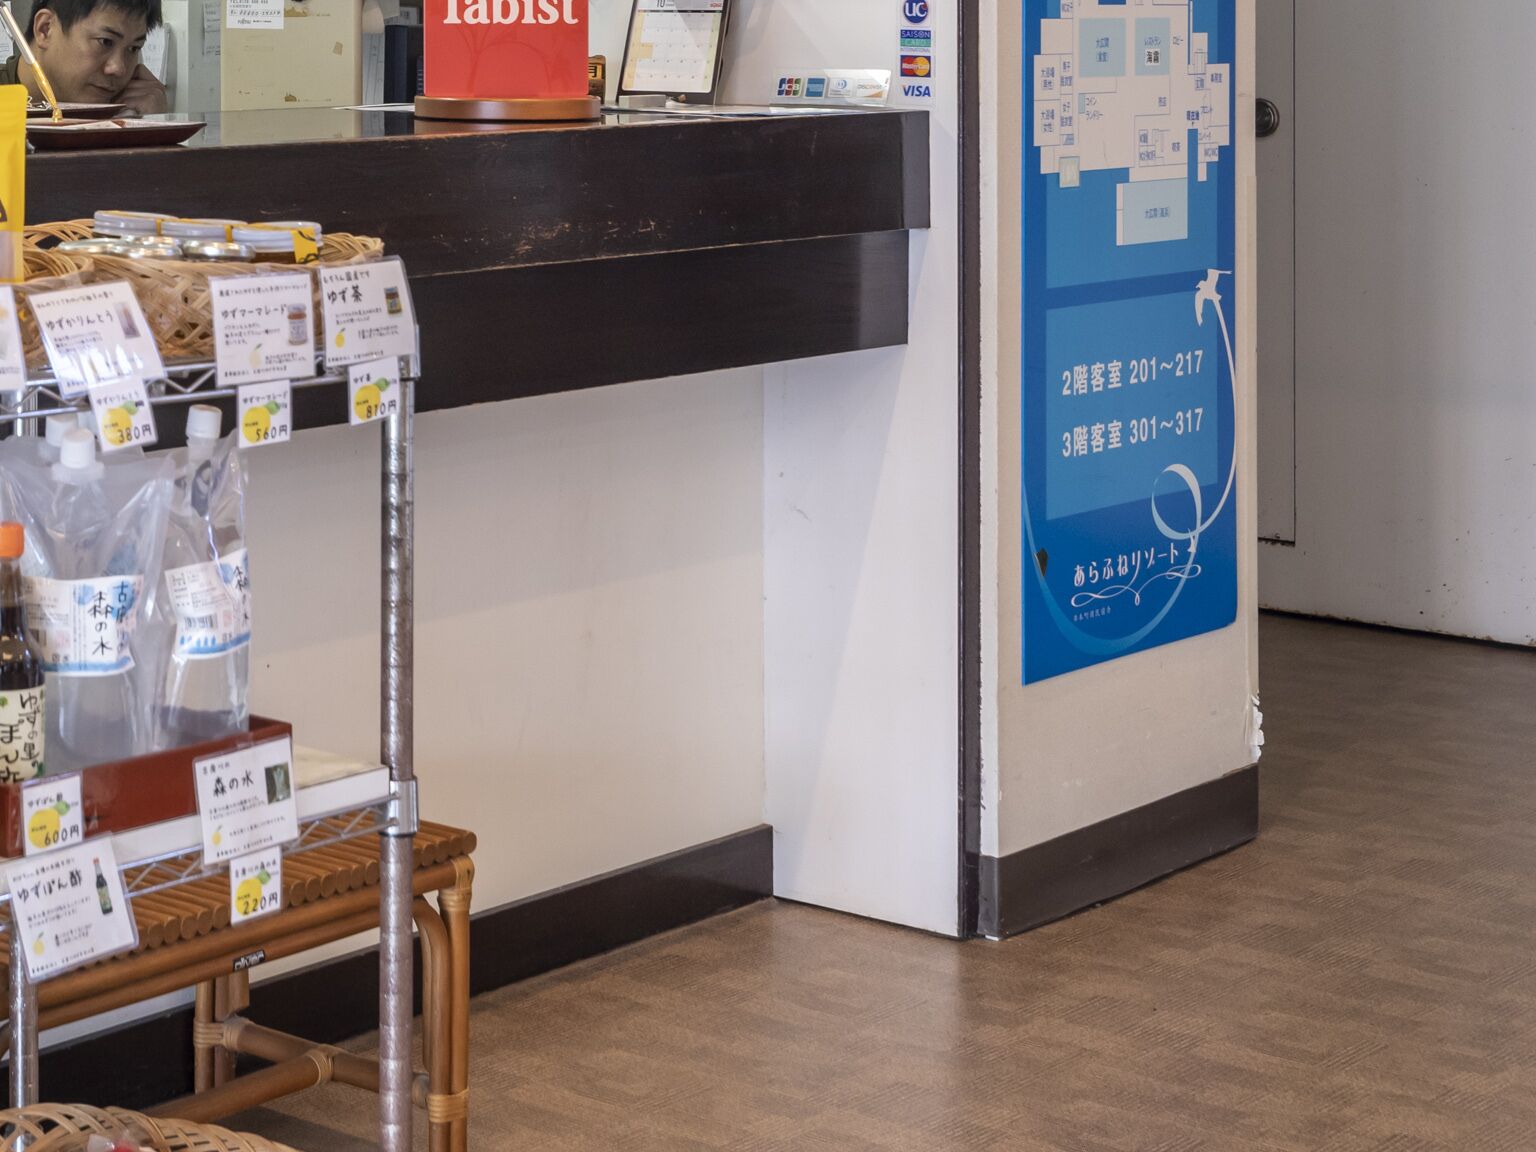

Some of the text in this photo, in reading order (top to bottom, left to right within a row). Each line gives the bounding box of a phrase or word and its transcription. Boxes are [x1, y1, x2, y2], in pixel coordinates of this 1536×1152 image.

[903, 85, 931, 97] VISA
[327, 284, 363, 305] ゆず茶
[45, 310, 113, 330] ゆずかりんとう
[222, 303, 287, 319] ゆずマーマレード
[1062, 359, 1122, 396] 2階客室
[118, 424, 152, 444] 380円
[255, 424, 288, 441] 560円
[1062, 420, 1122, 458] 3階客室
[1074, 542, 1178, 587] あらふねリゾート
[213, 770, 254, 797] 森の水
[44, 824, 79, 846] 600円
[17, 868, 82, 903] ゆずぽん酢
[243, 892, 278, 916] 220円
